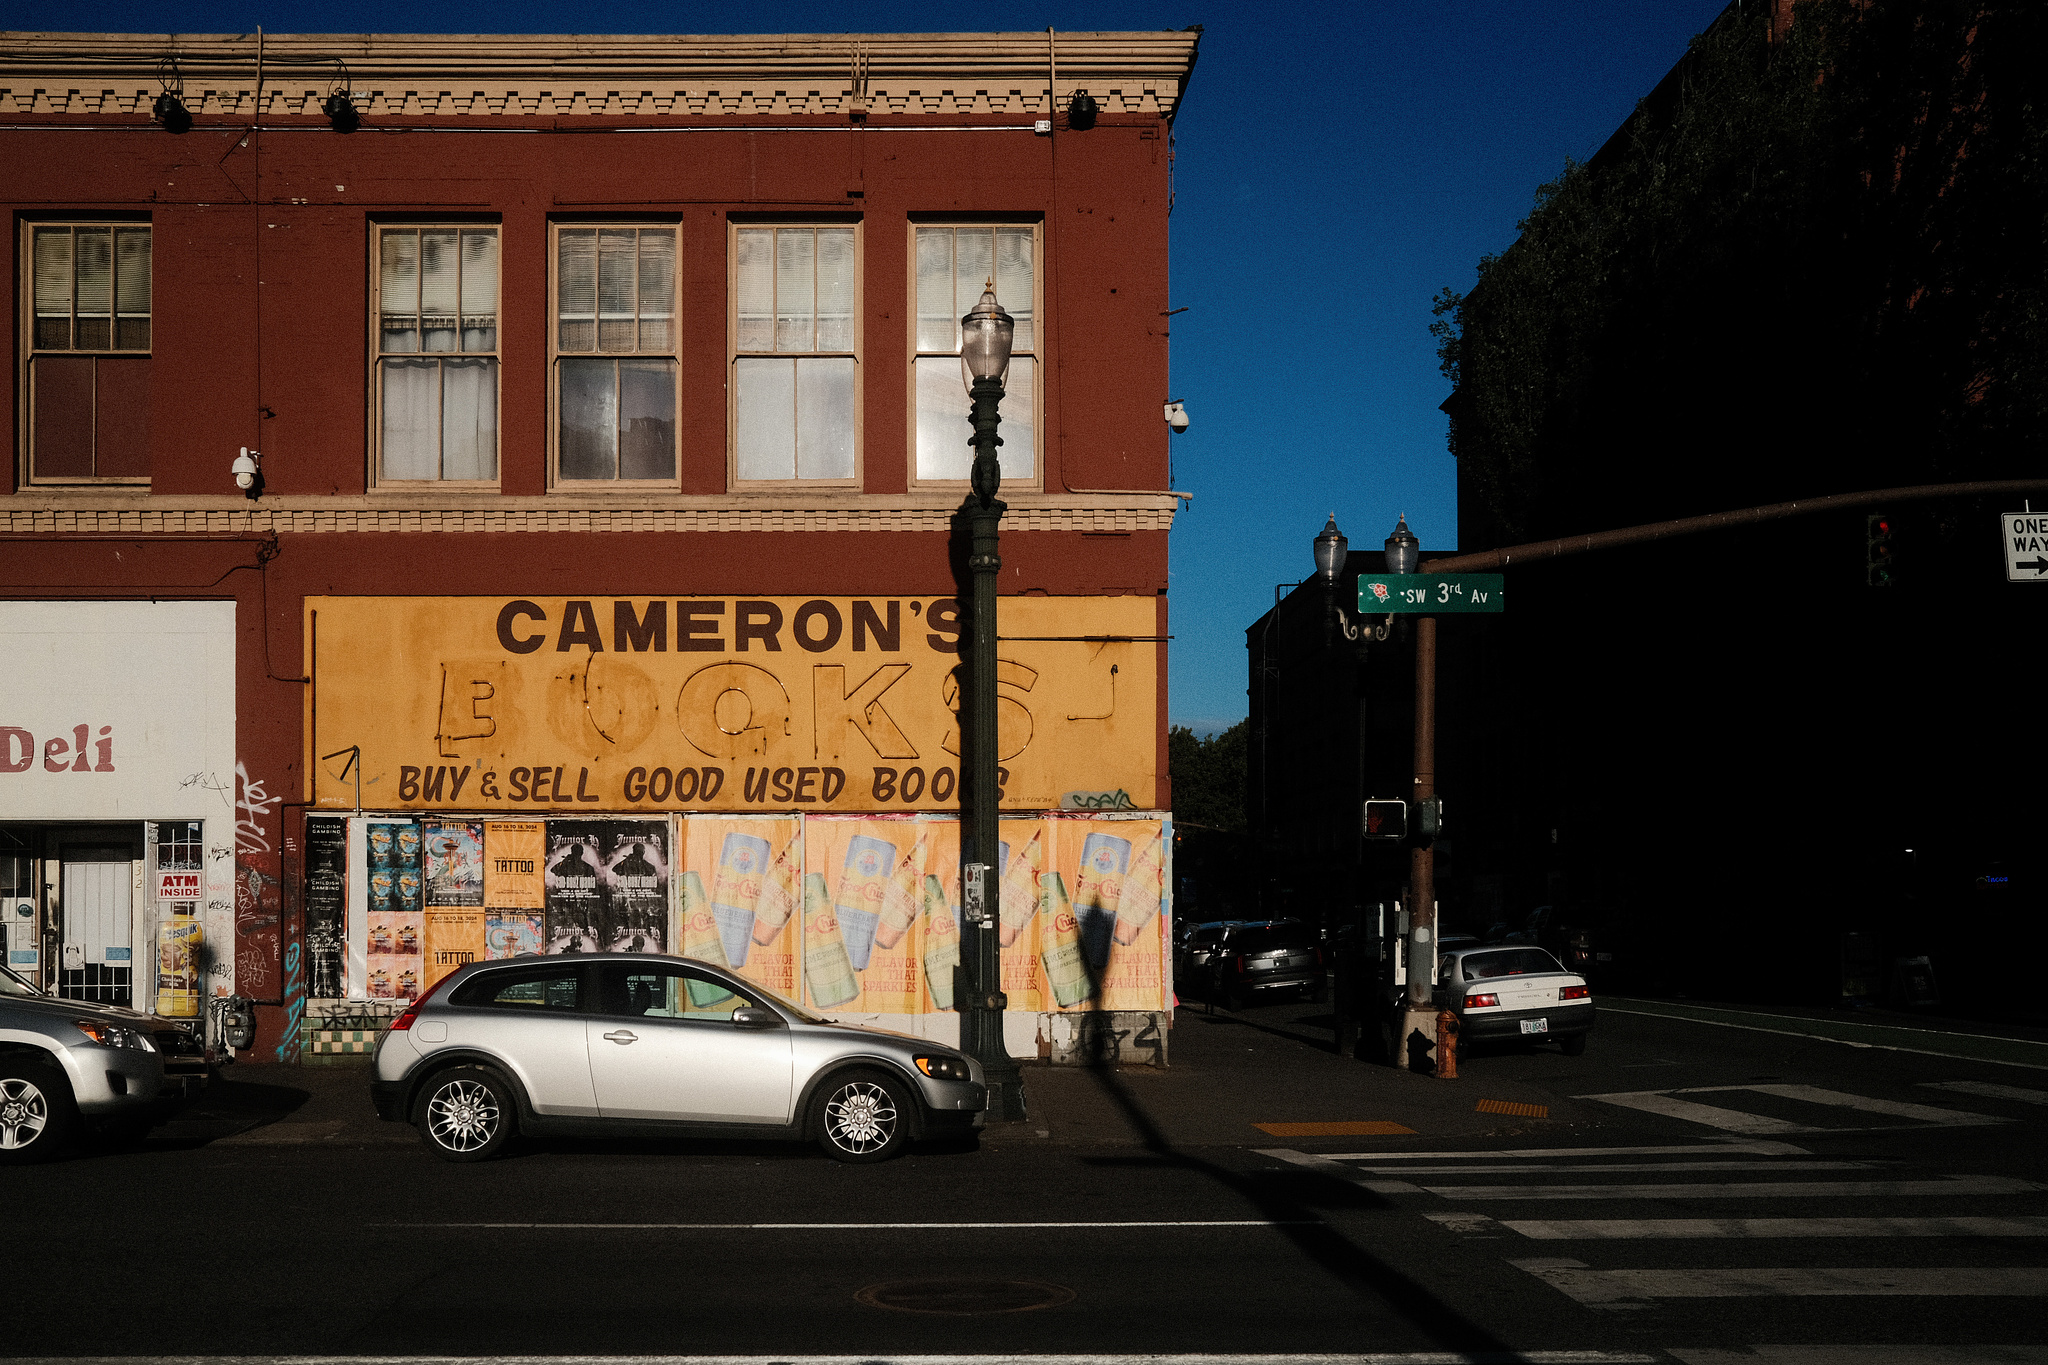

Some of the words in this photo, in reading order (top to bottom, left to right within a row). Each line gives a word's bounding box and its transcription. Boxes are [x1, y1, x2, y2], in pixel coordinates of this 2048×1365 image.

[2013, 519, 2047, 534] ONE
[2013, 537, 2047, 552] WAY
[1406, 589, 1426, 603] SW
[1437, 583, 1461, 603] 3rd
[1471, 589, 1488, 603] Av
[496, 599, 967, 654] CAMERON'S
[0, 724, 115, 773] Deli
[398, 765, 471, 802] BUY
[480, 766, 502, 802] &
[507, 766, 600, 802] SELL
[624, 766, 725, 802] GOOD
[744, 767, 846, 803] USED
[872, 766, 1010, 803] BOOS
[552, 834, 585, 852] Junior
[613, 834, 647, 849] Junior
[495, 860, 534, 872] TATTOO
[163, 876, 198, 887] ATM
[739, 879, 762, 899] Chic
[1100, 879, 1121, 899] Chic
[862, 882, 885, 902] Chic
[691, 912, 716, 932] Chic
[815, 915, 840, 934] Chic
[931, 916, 956, 935] Chic
[1055, 914, 1077, 933] Chic
[612, 926, 648, 941] Junior
[435, 952, 474, 964] TATTOO
[753, 954, 794, 965] FLAVOR
[875, 957, 918, 969] FLAVOR
[1000, 954, 1037, 966] LAVOR
[1114, 953, 1159, 964] FLAVOR
[764, 966, 793, 977] THAT
[887, 969, 917, 981] THAT
[1007, 967, 1037, 978] THAT
[1126, 965, 1157, 976] THAT
[763, 979, 794, 989] RKLES
[863, 981, 917, 992] SPARKLES
[1000, 979, 1037, 990] RKLES
[1104, 978, 1159, 989] SPARKLES
